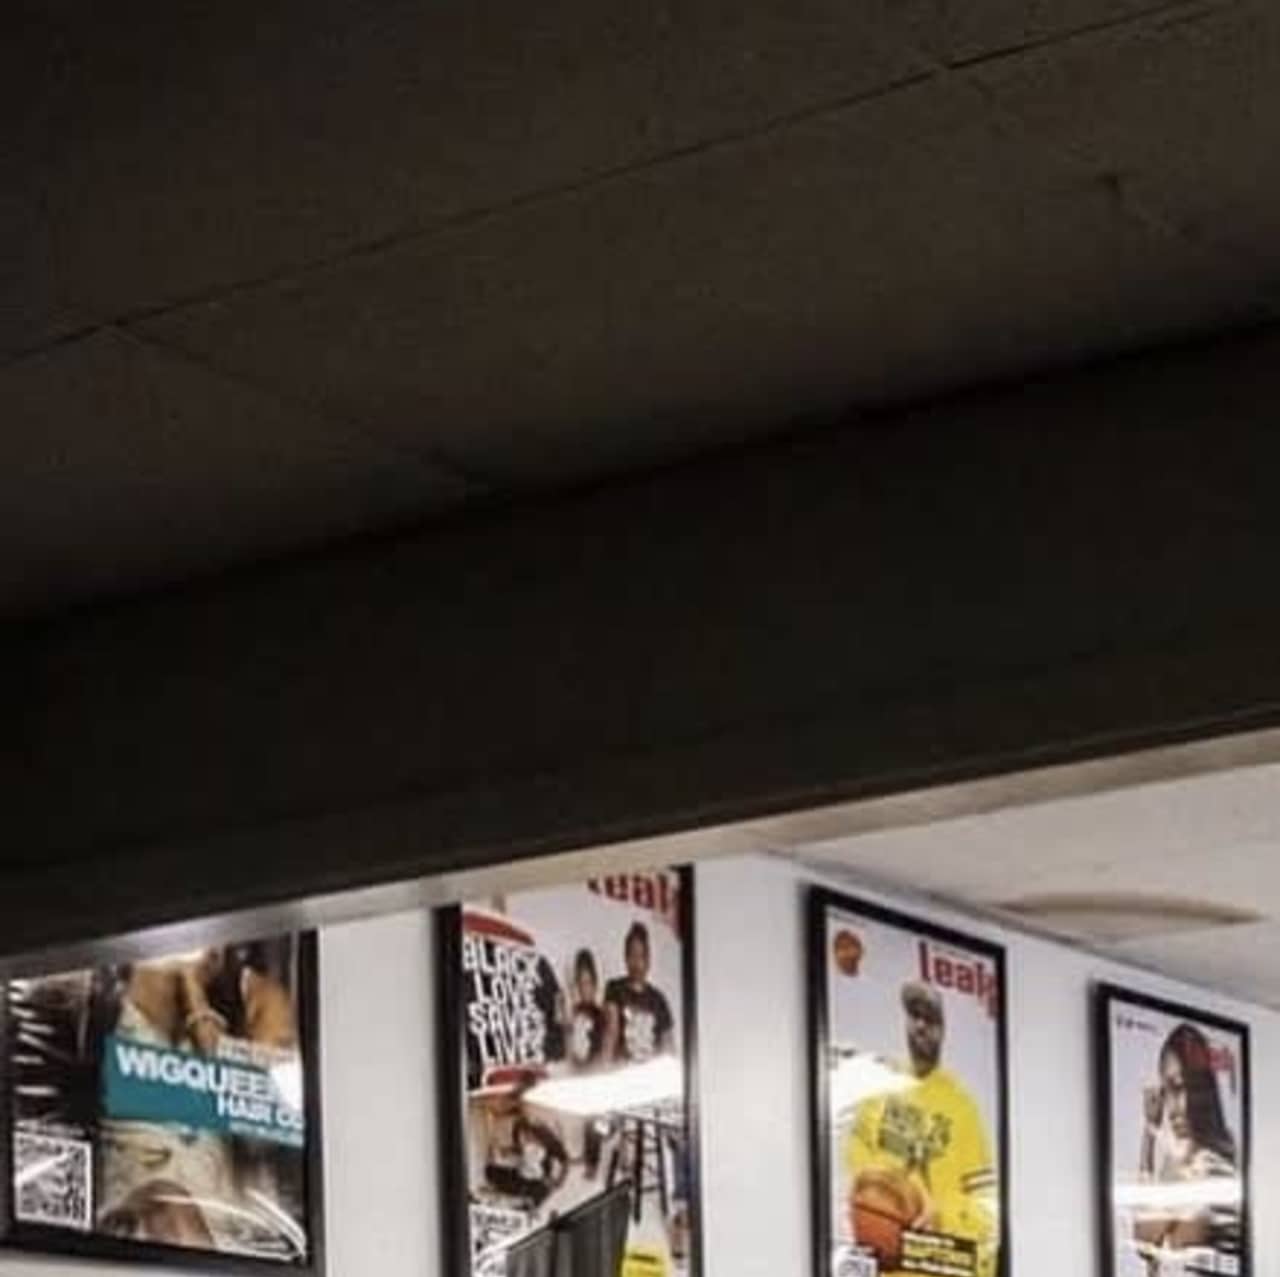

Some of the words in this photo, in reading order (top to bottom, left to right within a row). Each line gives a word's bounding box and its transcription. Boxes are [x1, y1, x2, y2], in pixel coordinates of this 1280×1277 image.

[462, 936, 543, 986] BLACK
[474, 967, 538, 1007] LOVE
[467, 1000, 545, 1043] SAVES
[480, 1031, 547, 1068] LIVES
